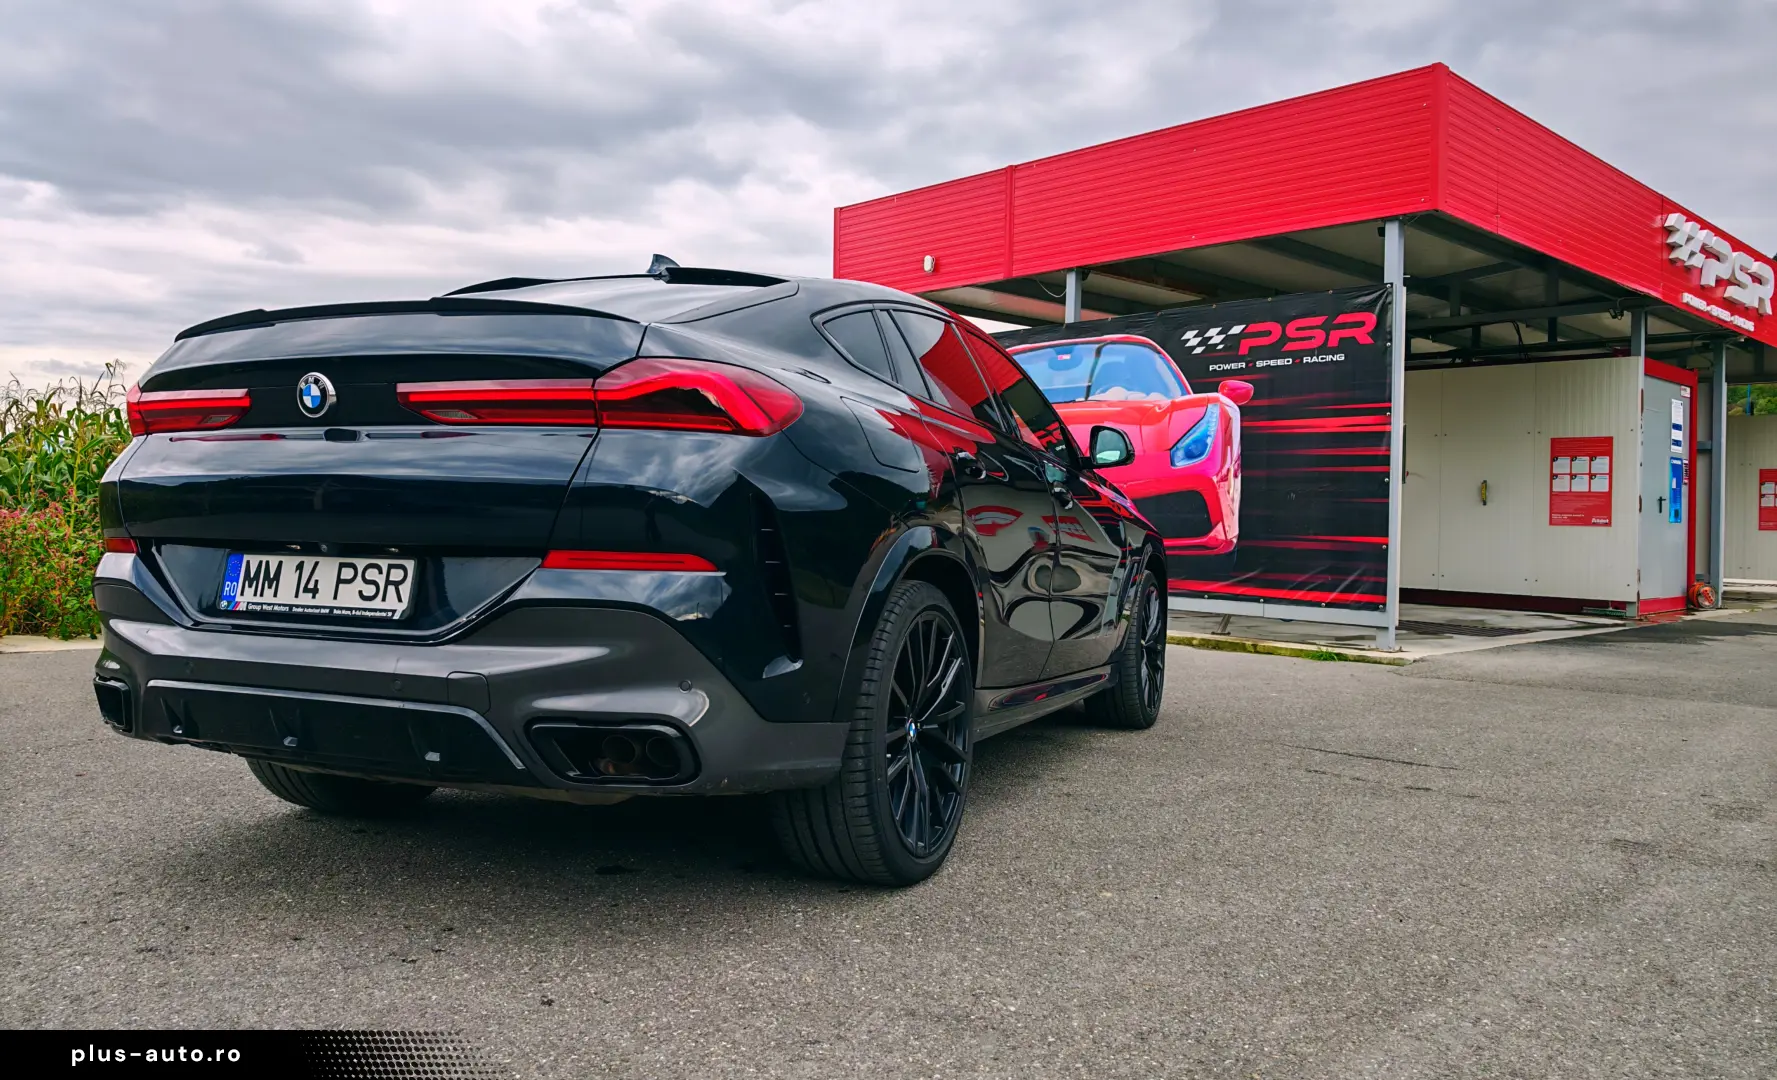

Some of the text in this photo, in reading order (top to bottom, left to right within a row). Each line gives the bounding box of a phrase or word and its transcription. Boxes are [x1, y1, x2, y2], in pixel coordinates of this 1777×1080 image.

[1700, 236, 1775, 315] PSR
[1238, 311, 1378, 355] PSR
[1209, 353, 1345, 372] POWER SPEED RACING
[223, 581, 237, 597] RO
[239, 559, 409, 603] MM 14 PSR
[248, 603, 261, 611] Group
